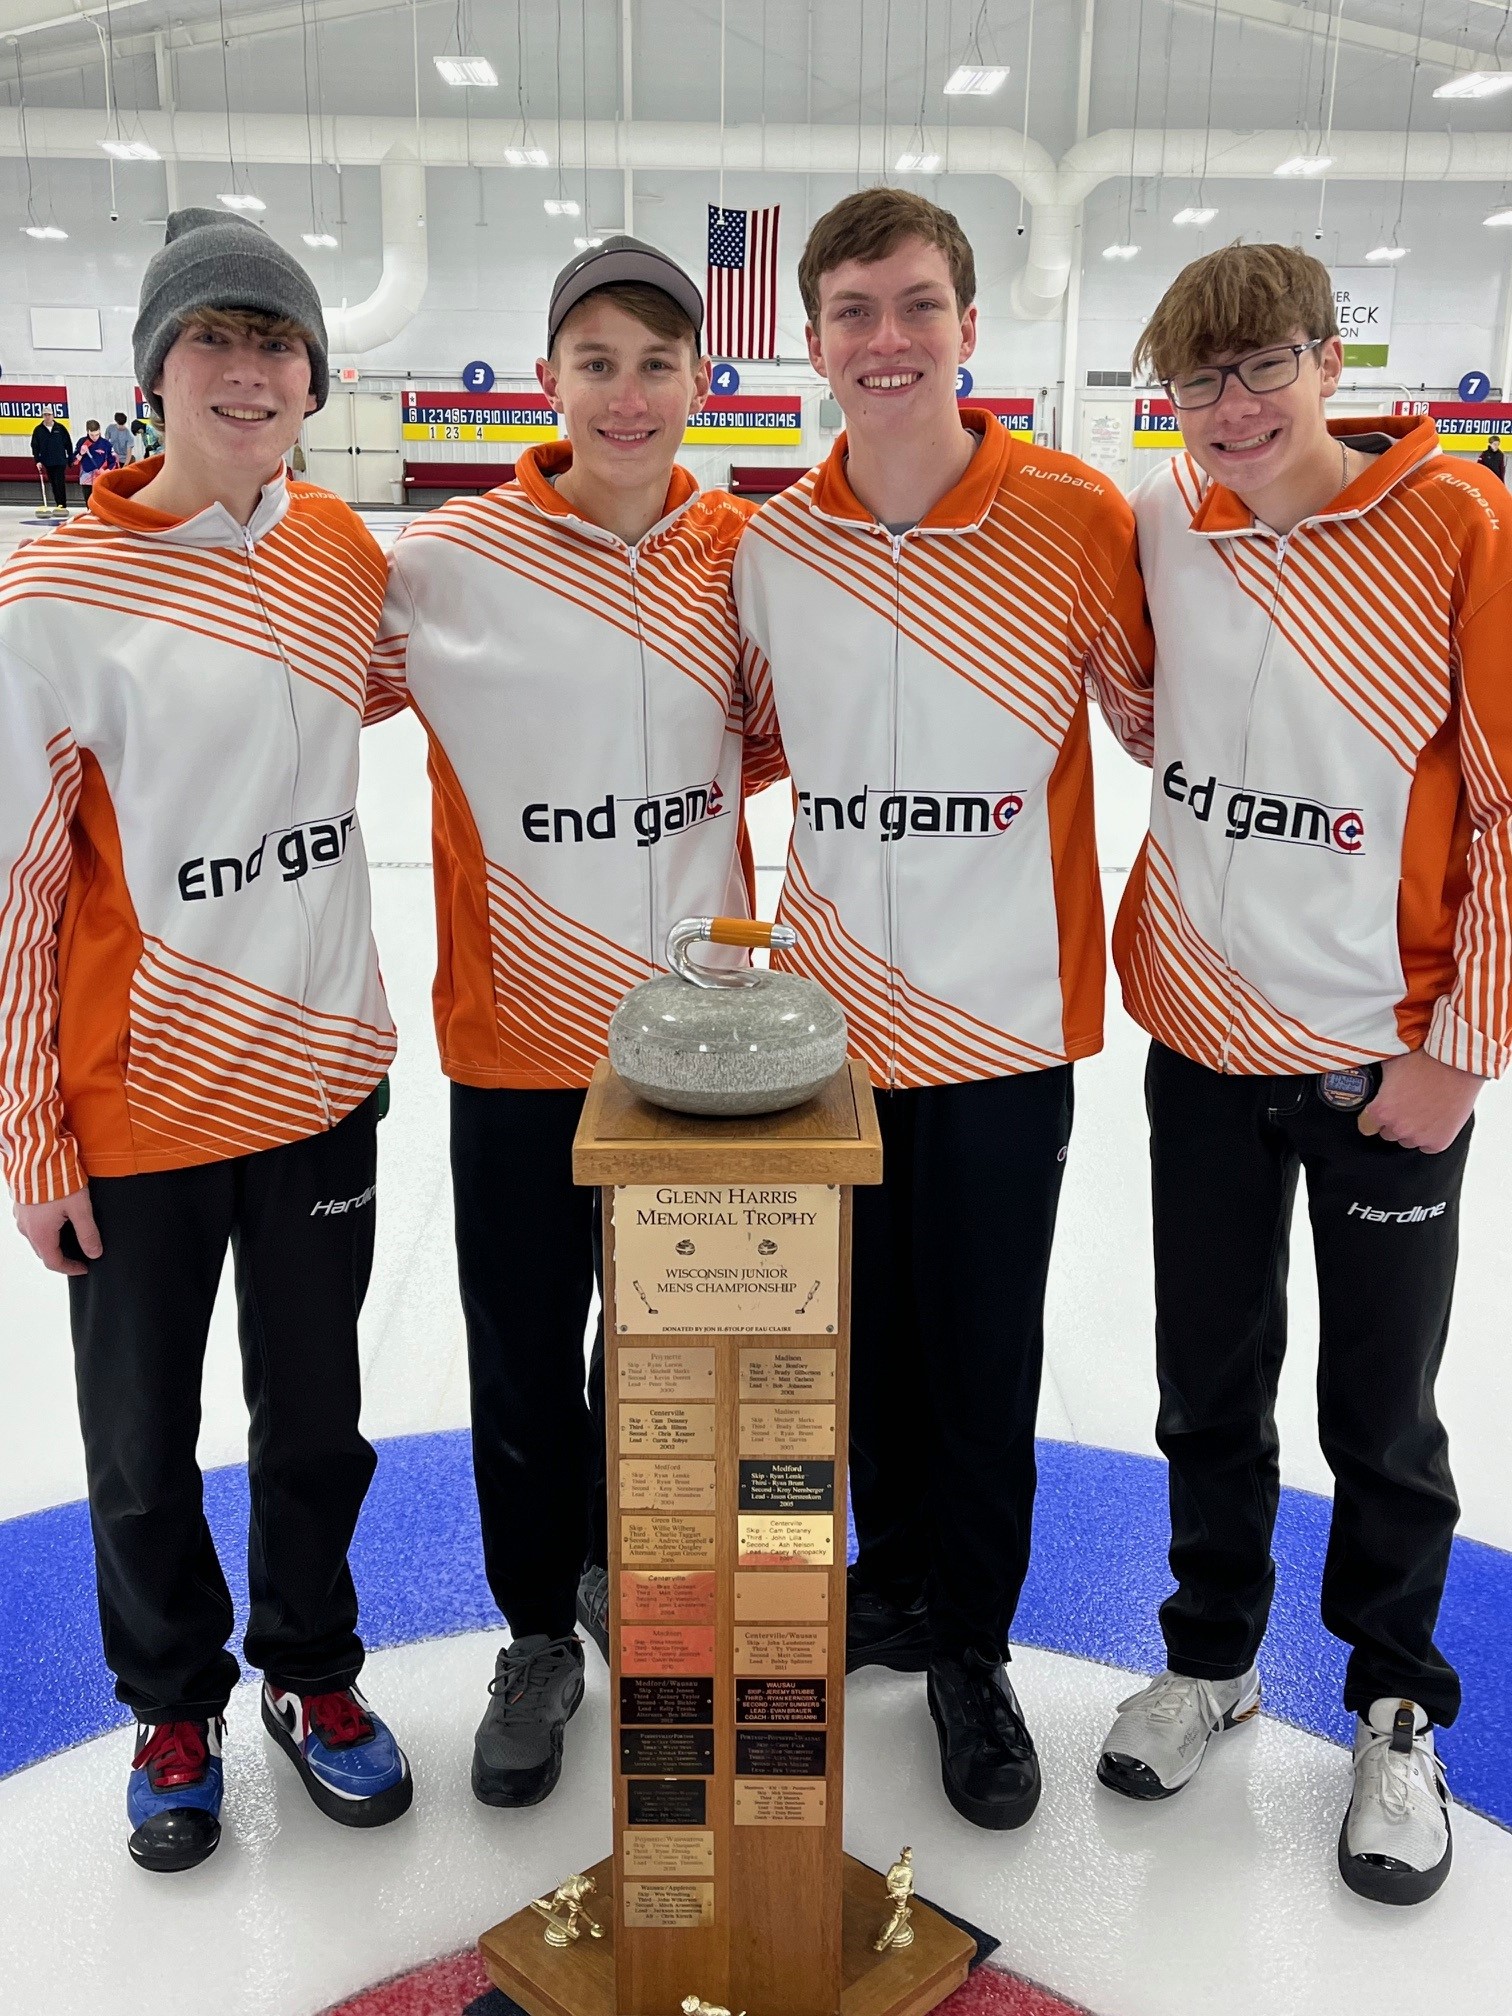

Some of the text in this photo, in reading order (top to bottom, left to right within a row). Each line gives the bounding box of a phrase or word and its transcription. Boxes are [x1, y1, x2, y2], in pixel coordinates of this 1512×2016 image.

[1333, 291, 1350, 303] ER
[1336, 306, 1379, 324] ECK
[1340, 327, 1359, 338] ON
[472, 368, 485, 385] 3
[717, 371, 730, 388] 4
[1468, 378, 1481, 394] 7
[1020, 464, 1105, 496] Runback
[1432, 472, 1500, 530] Runback
[522, 780, 724, 848] End game
[880, 794, 1024, 842] game
[1225, 792, 1364, 852] game
[178, 832, 268, 902] End
[656, 1188, 797, 1205] GLENN HARRIS
[636, 1210, 818, 1226] MEMORIAL TROPHY
[1347, 1201, 1446, 1223] Hardline
[665, 1268, 788, 1280] WISCONSIN JUNIOR
[657, 1283, 797, 1294] MENS CHAMPIONSHIP
